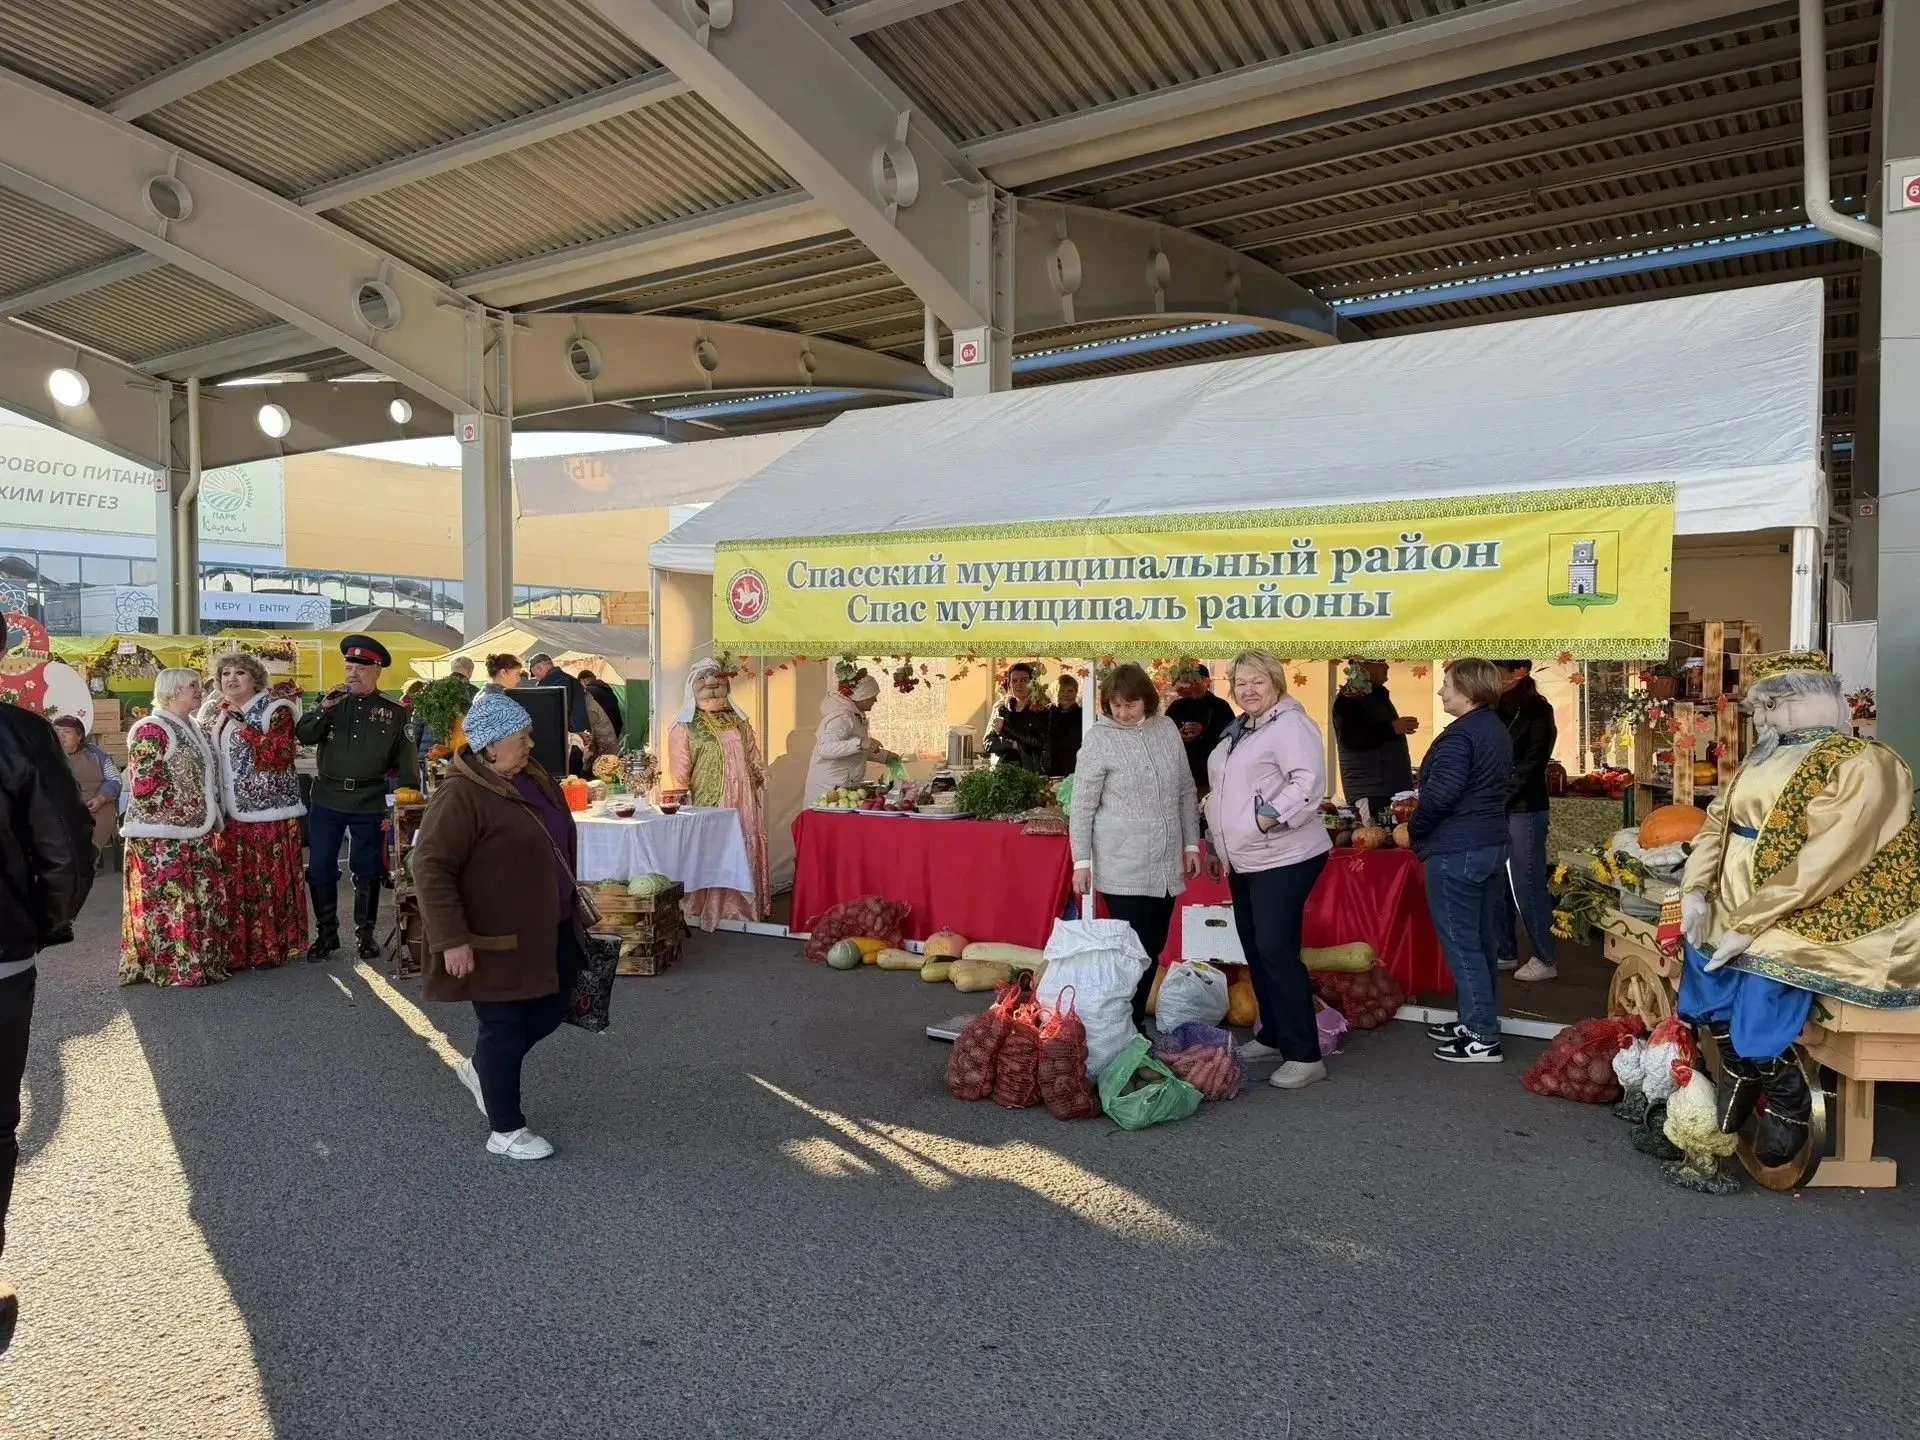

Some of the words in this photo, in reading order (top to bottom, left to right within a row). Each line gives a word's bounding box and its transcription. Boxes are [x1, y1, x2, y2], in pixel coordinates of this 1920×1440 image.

[50, 490, 119, 510] ИТЕГЕЗ
[202, 515, 247, 535] Казань
[212, 511, 237, 521] ПАРК
[786, 552, 946, 590] Спасский
[955, 537, 1319, 593] муниципальный
[1329, 532, 1501, 584] район
[259, 603, 291, 613] ENTRY
[847, 594, 928, 624] Спас
[935, 595, 1188, 631] муниципаль
[1195, 582, 1393, 630] районы
